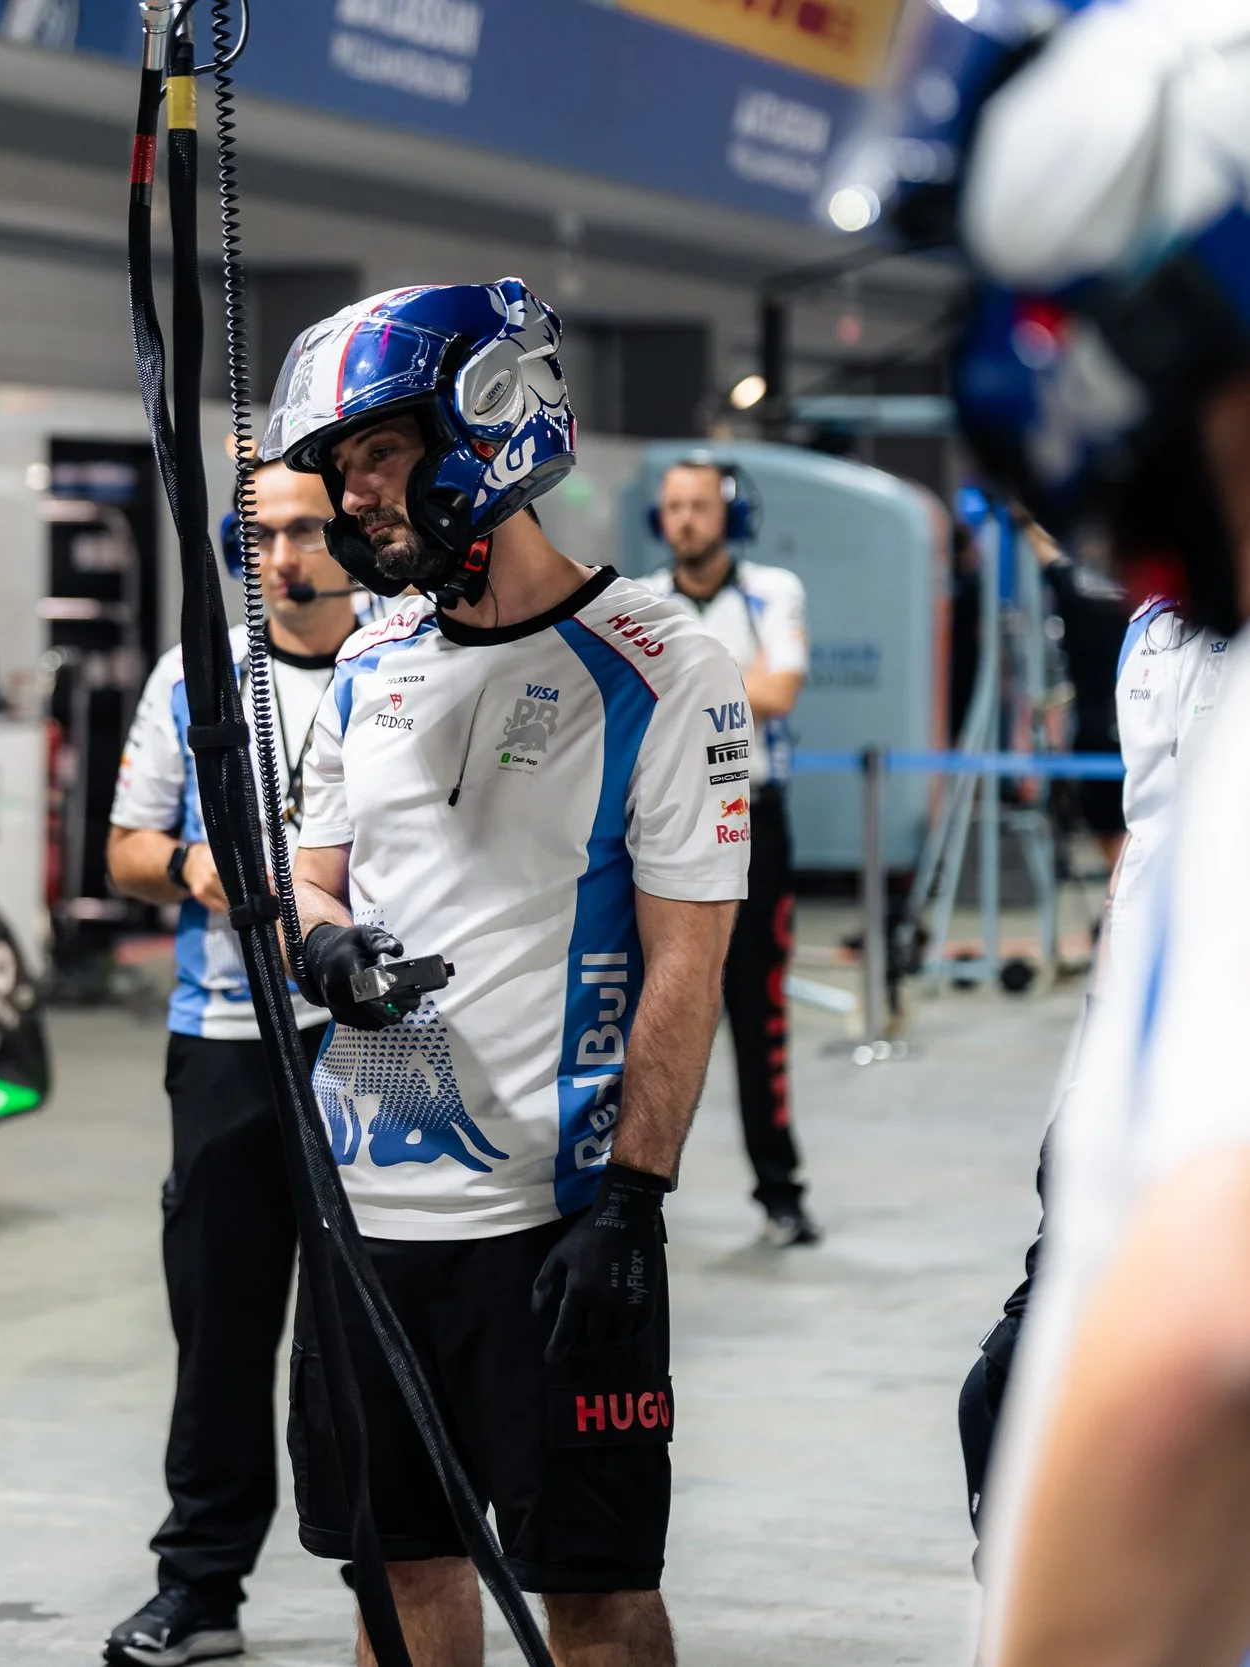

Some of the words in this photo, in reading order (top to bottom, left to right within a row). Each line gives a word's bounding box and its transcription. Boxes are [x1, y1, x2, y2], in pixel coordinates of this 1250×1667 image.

[486, 381, 503, 400] MARZI
[386, 676, 425, 684] HONDA
[526, 684, 559, 702] VISA
[375, 714, 414, 730] TUDOR
[702, 701, 747, 733] VISA
[575, 952, 628, 1066] Bull
[575, 1391, 670, 1432] HUGO
